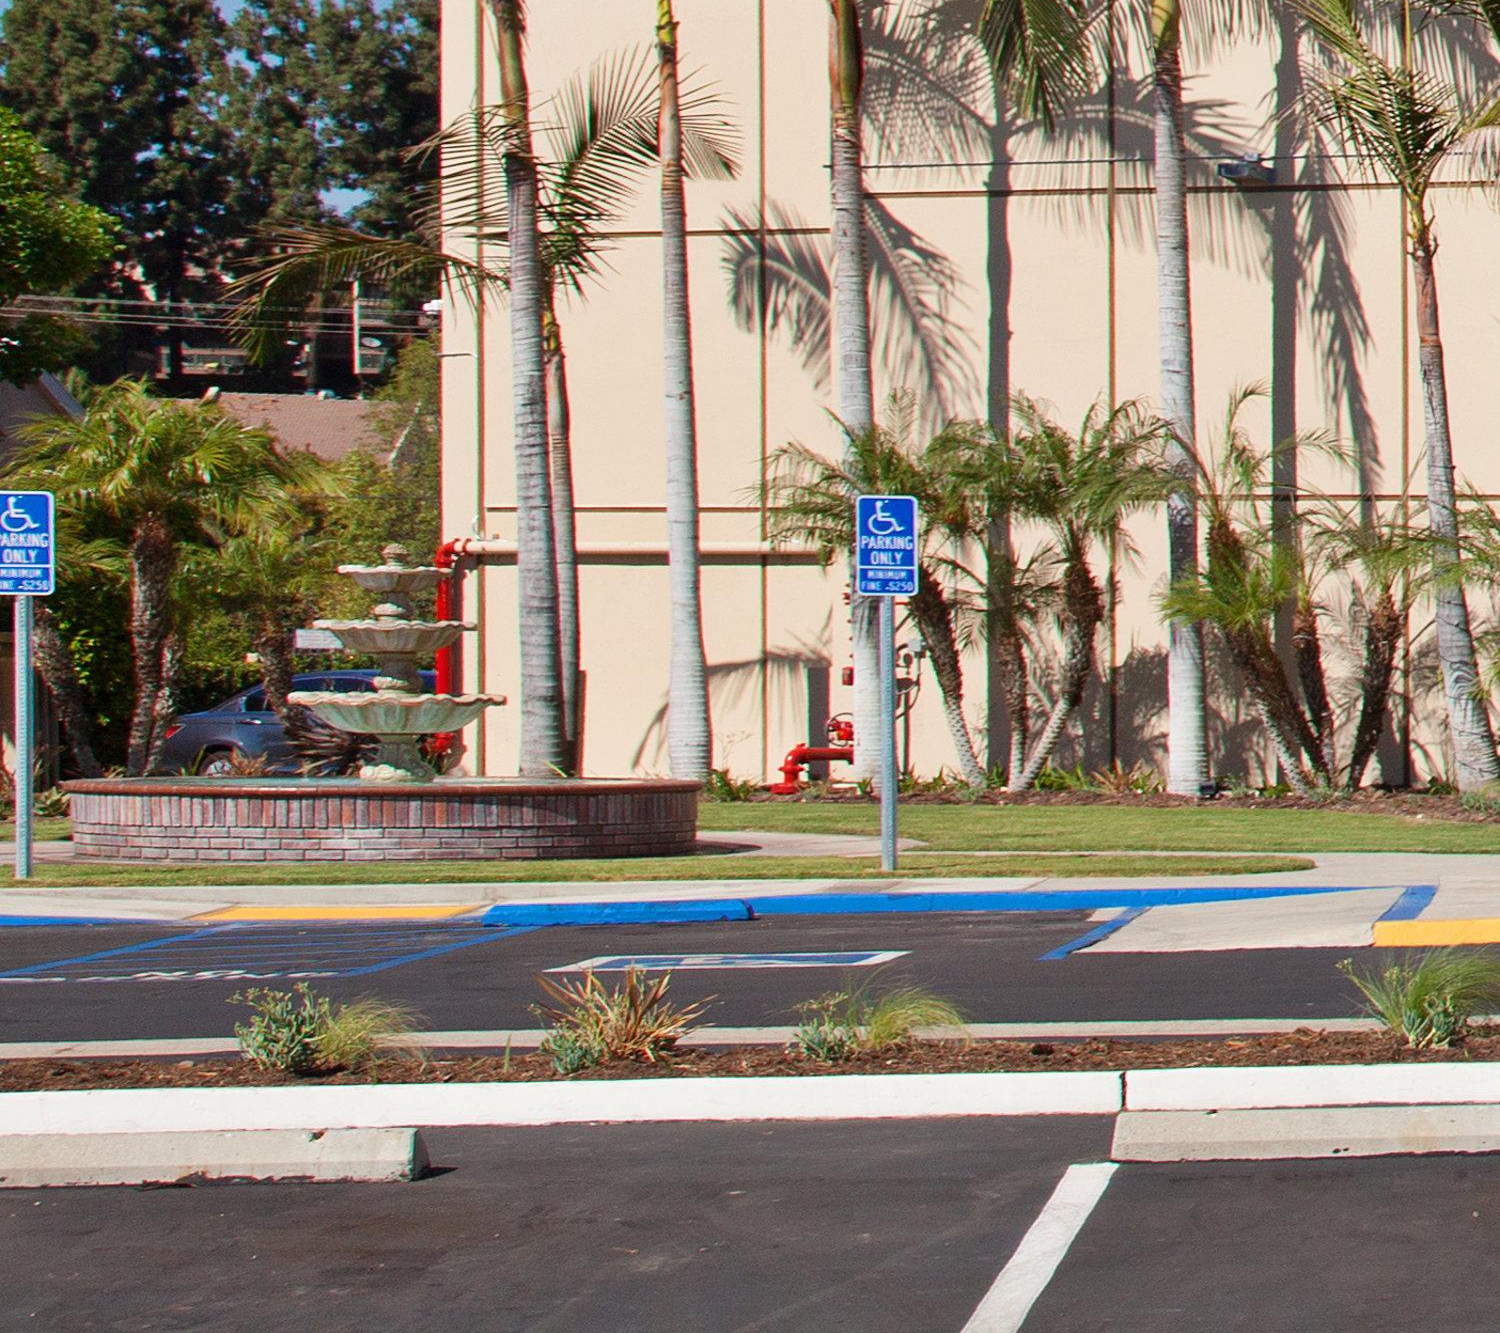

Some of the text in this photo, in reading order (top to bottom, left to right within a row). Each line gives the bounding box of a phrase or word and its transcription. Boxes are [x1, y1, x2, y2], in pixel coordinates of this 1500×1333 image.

[0, 533, 49, 547] ARKING
[861, 535, 913, 550] PARKING
[2, 549, 38, 563] ONLY
[870, 551, 904, 565] ONLY
[867, 570, 907, 580] MINIMUM
[861, 581, 882, 591] FINE
